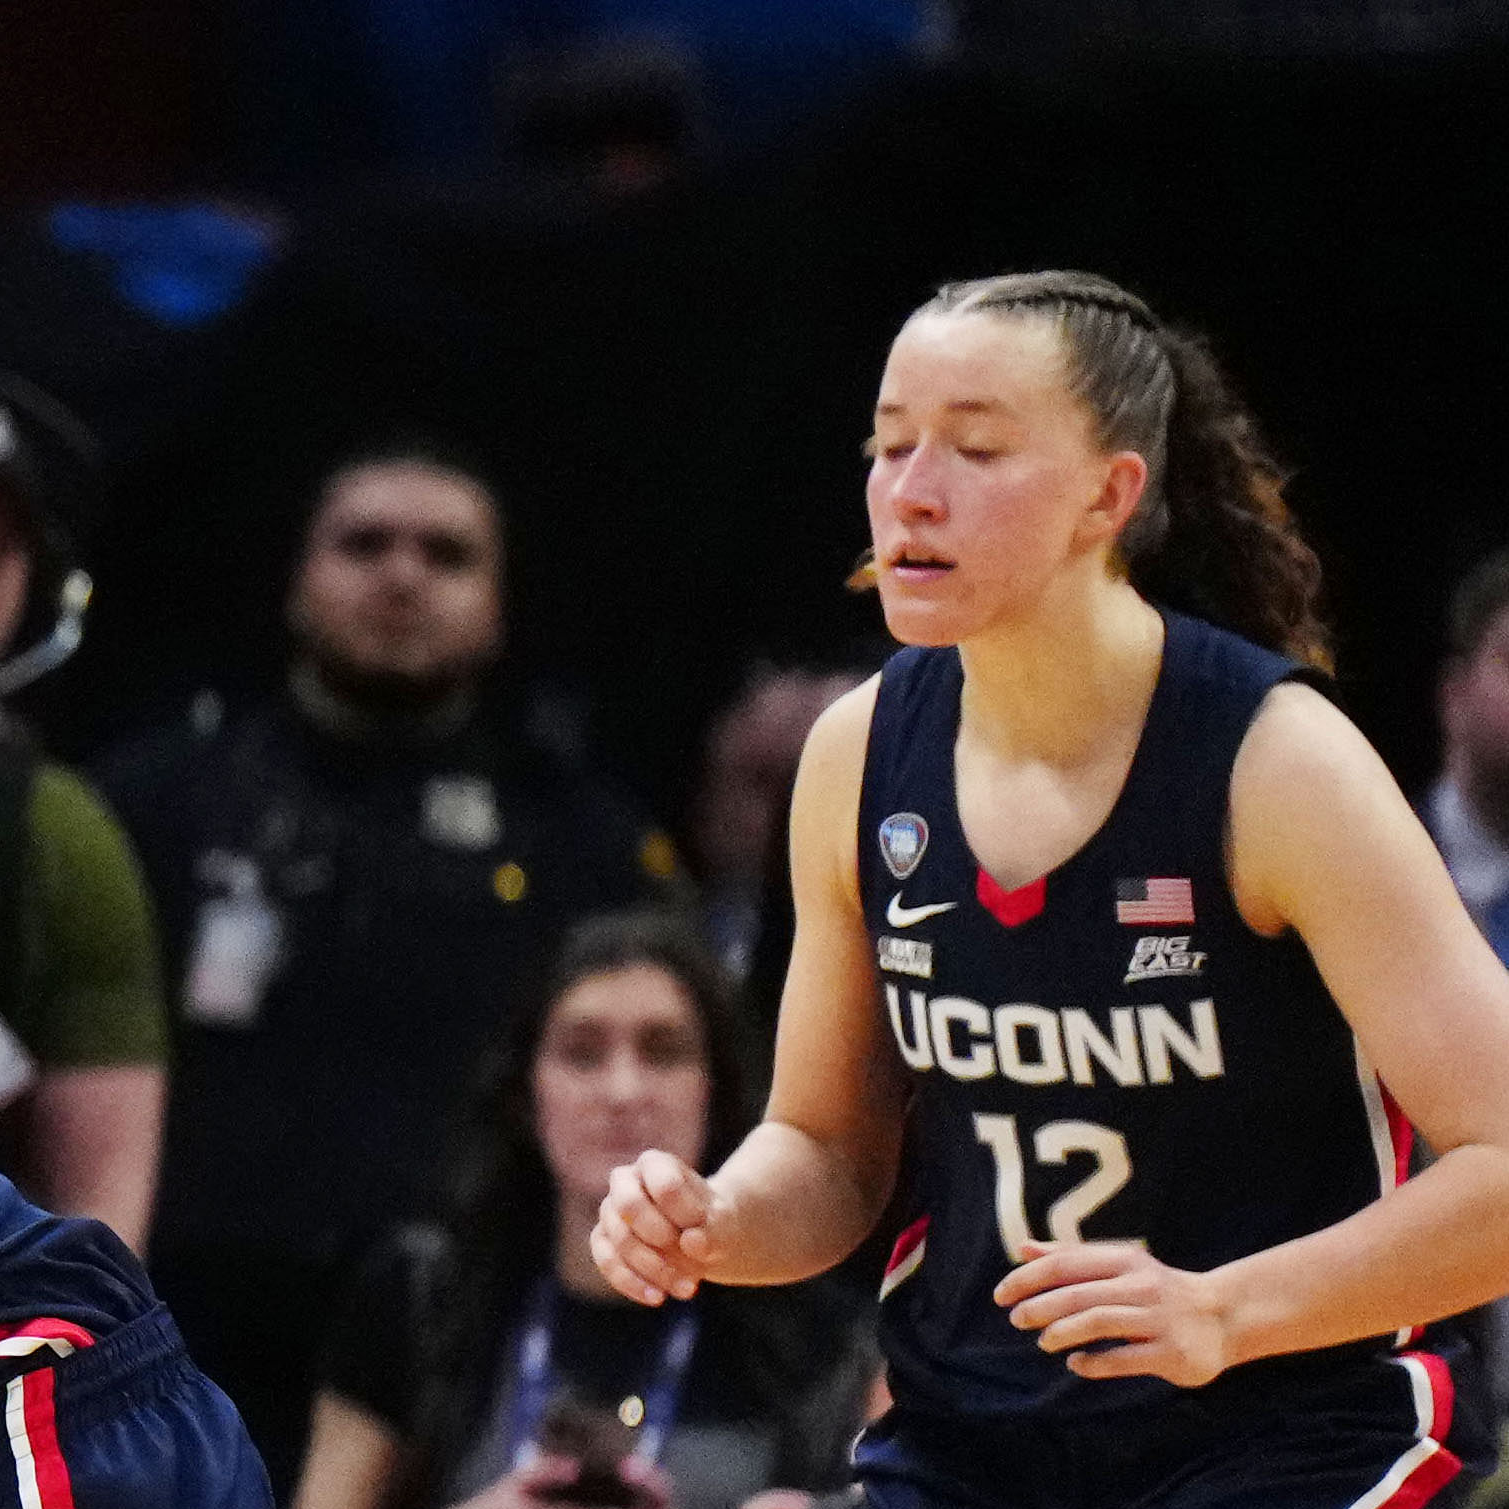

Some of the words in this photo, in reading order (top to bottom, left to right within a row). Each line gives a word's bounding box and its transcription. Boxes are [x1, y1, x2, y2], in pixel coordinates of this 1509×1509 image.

[1127, 951, 1208, 972] EAST
[1134, 935, 1191, 953] BIG
[885, 983, 1226, 1087] UCONN
[972, 1112, 1148, 1264] 12
